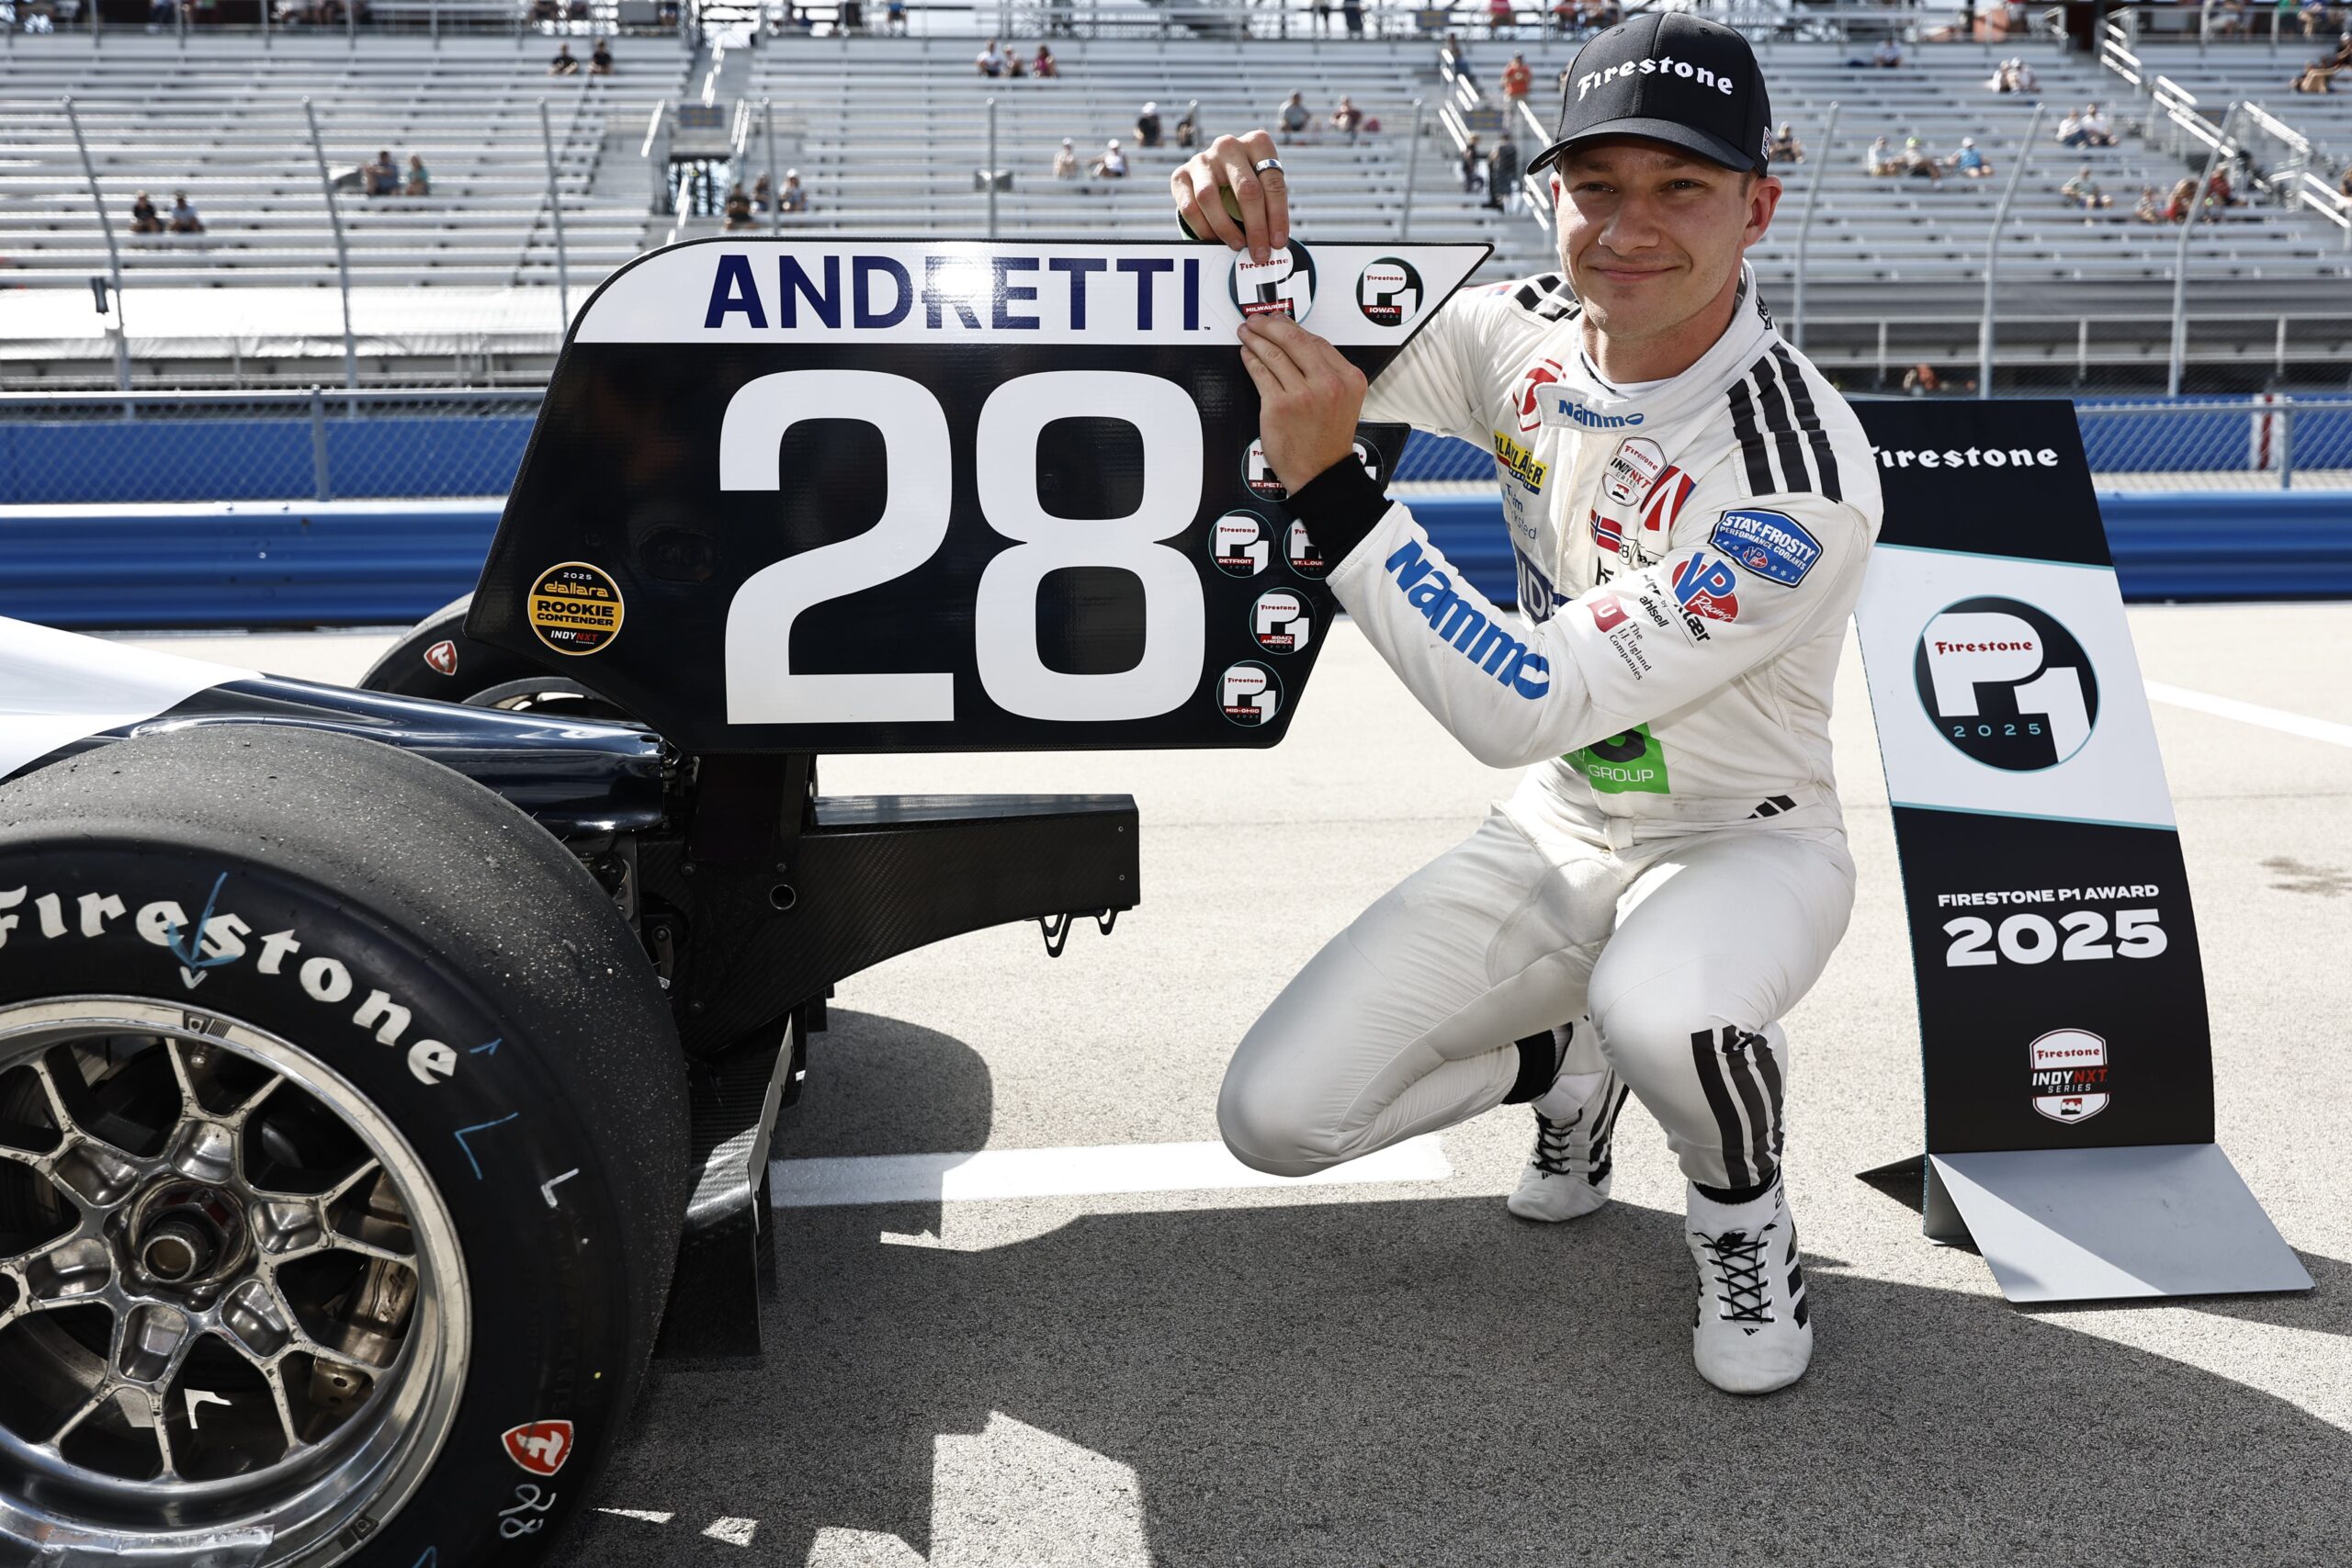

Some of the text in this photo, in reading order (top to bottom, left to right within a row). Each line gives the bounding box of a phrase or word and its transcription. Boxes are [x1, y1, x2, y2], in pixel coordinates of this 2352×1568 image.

[1577, 56, 1733, 102] Firestone
[704, 254, 1200, 331] ANDRETTI
[1245, 302, 1290, 313] MILWAUKEE
[1558, 399, 1645, 428] Nammo
[1624, 445, 1658, 470] Firestone
[719, 369, 1205, 724] 28
[1719, 525, 1807, 570] PERFORMANCE COOLANTS
[1760, 524, 1816, 562] FROSTY
[563, 571, 593, 581] 2025
[1673, 551, 1737, 606] VP
[544, 581, 609, 598] dallara
[537, 600, 615, 618] ROOKIE
[537, 613, 615, 626] CONTENDER
[1385, 536, 1550, 700] Nammo
[1639, 596, 1670, 628] ahlsell
[1690, 595, 1736, 622] Racing
[1629, 621, 1644, 641] The
[1609, 634, 1644, 681] Companies
[1627, 640, 1652, 672] Ugland
[1935, 641, 2034, 655] Firestone
[1953, 723, 2041, 738] 2025
[1588, 764, 1655, 783] GROUP
[1938, 885, 2159, 908] FIRESTONE P1 AWARD
[1942, 908, 2168, 967] 2025
[2036, 1048, 2101, 1061] Firestone
[2047, 1084, 2091, 1094] SERIES
